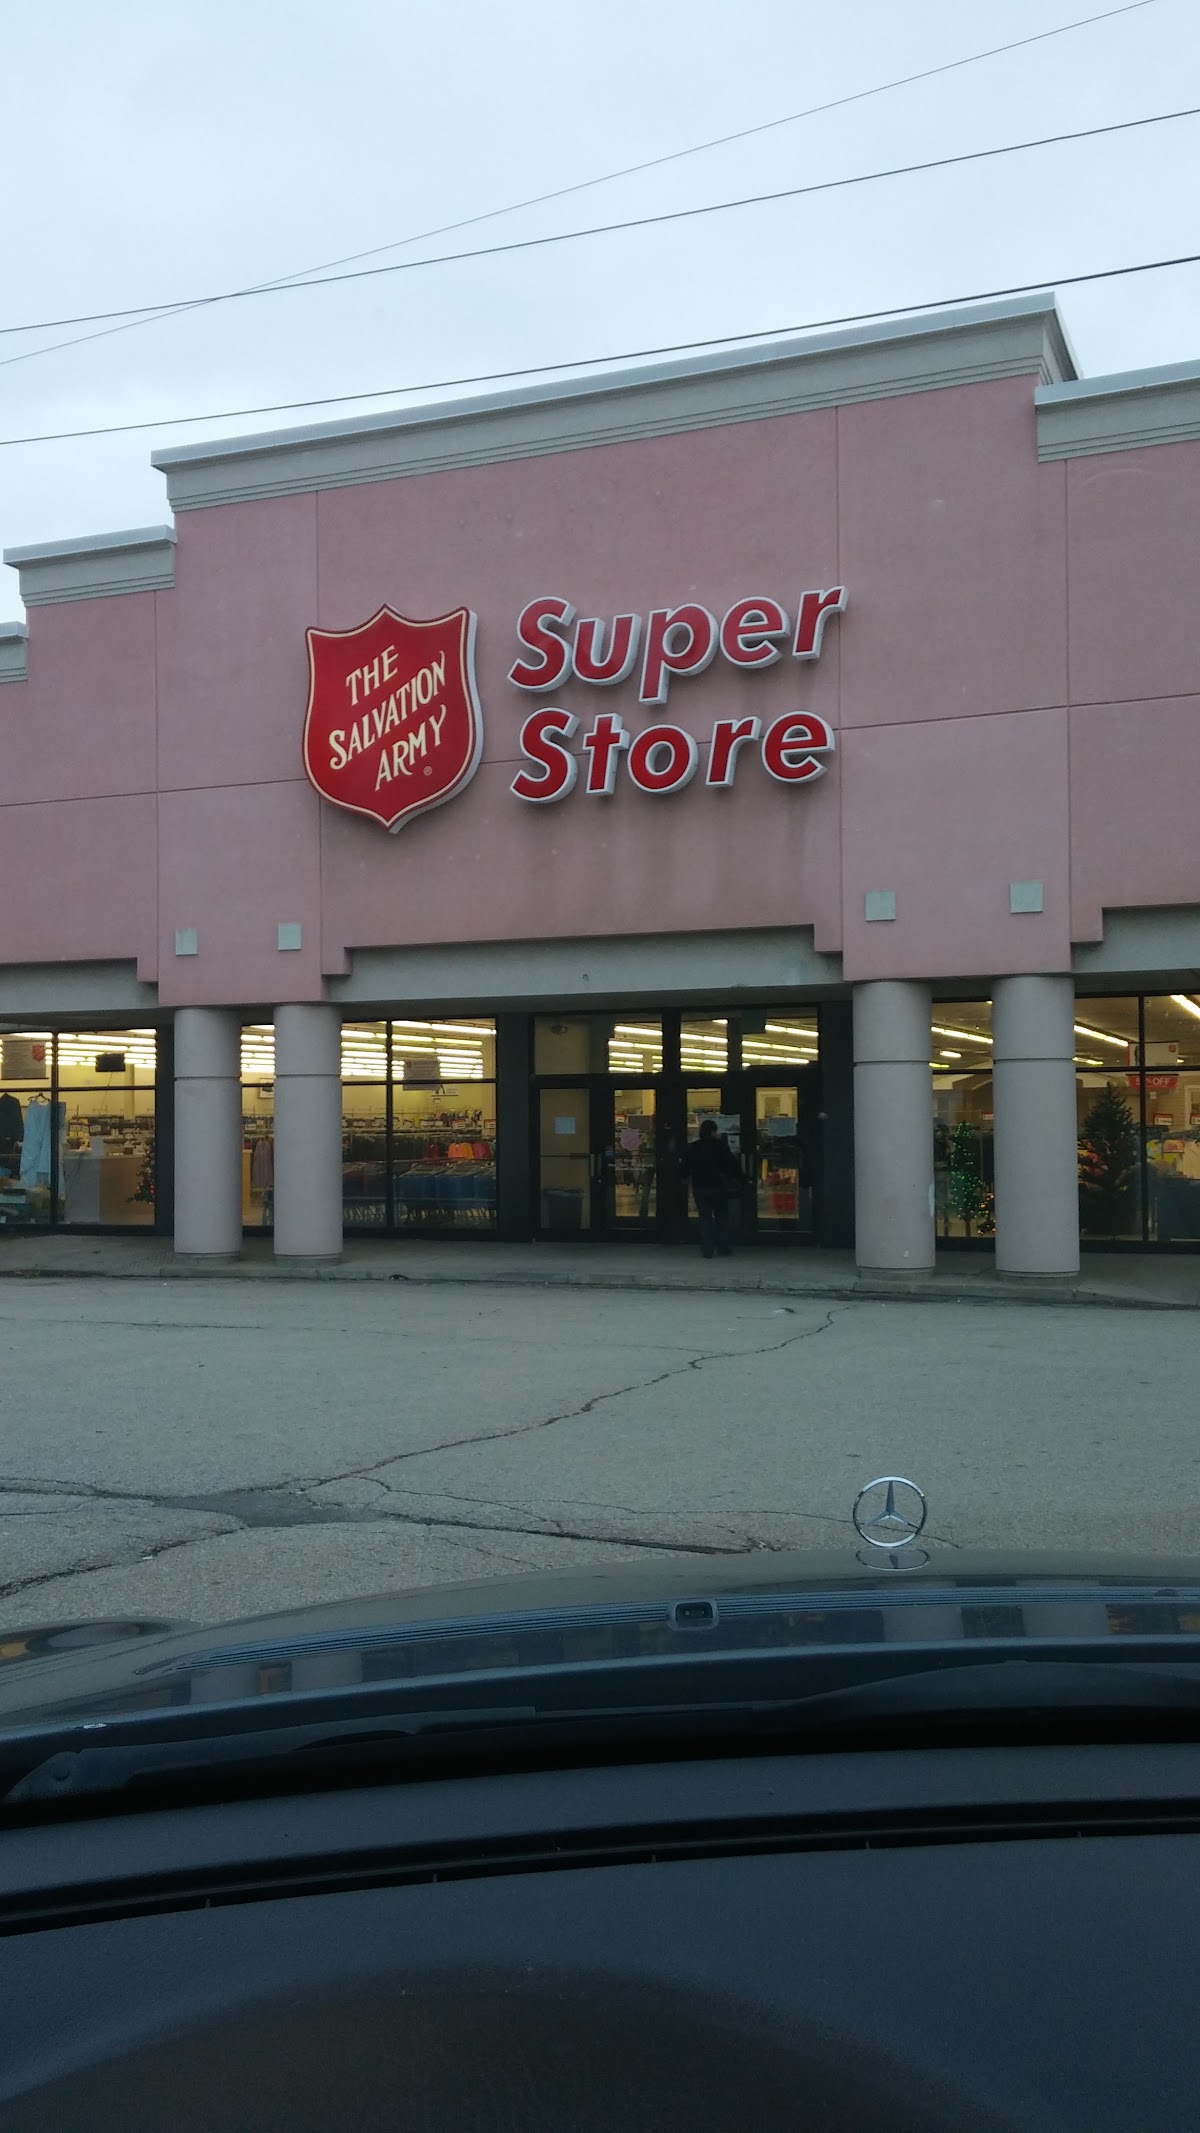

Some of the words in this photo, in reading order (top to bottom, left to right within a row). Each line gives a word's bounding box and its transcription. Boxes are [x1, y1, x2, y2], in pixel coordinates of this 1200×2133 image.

[346, 645, 399, 706] THE
[507, 586, 847, 704] Super
[329, 650, 445, 770] SALVATION
[375, 704, 447, 792] ARMY
[510, 707, 835, 803] Store
[1152, 1077, 1171, 1086] OFF
